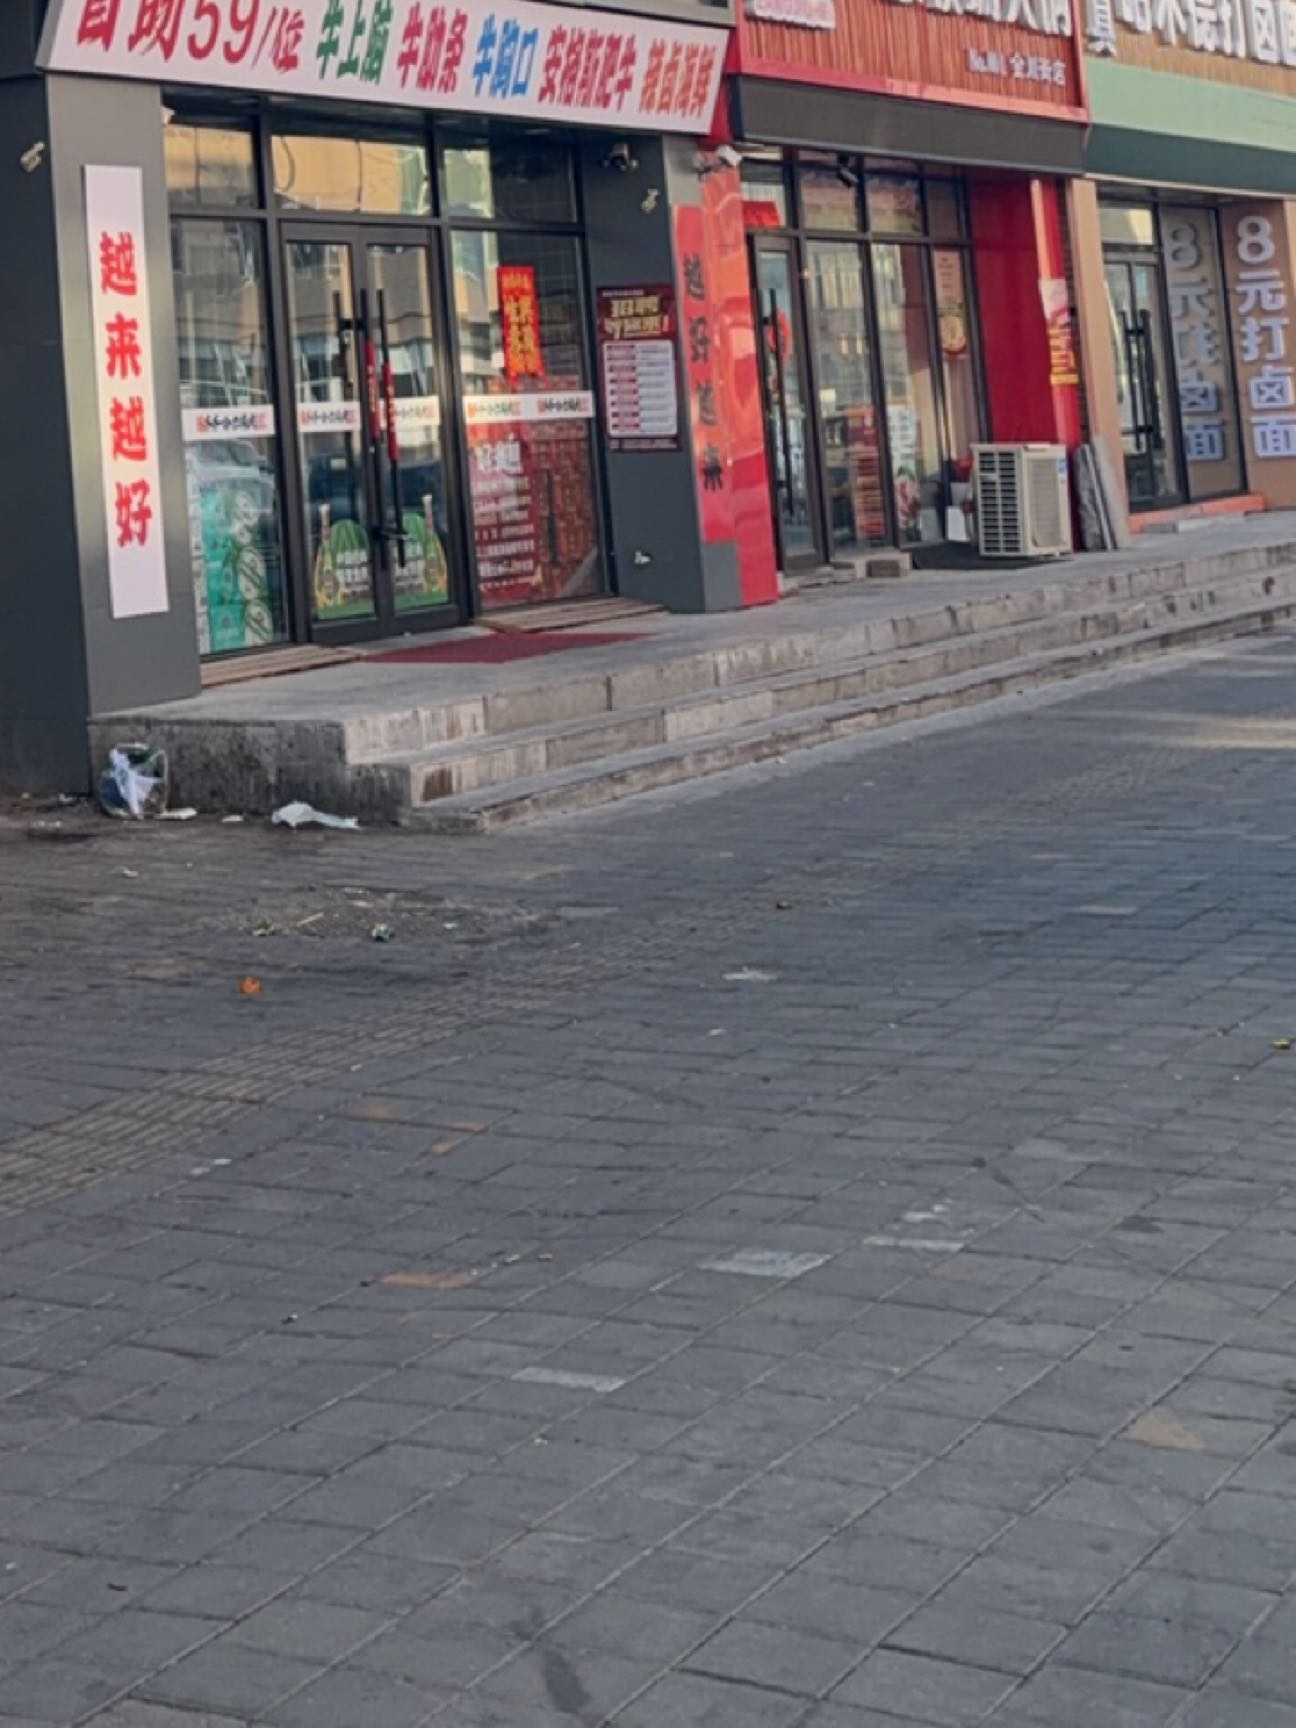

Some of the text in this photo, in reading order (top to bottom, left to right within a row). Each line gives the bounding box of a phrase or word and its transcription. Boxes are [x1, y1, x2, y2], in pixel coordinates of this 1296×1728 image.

[98, 230, 154, 550] 越来越好
[1236, 214, 1296, 460] 8元打卤面
